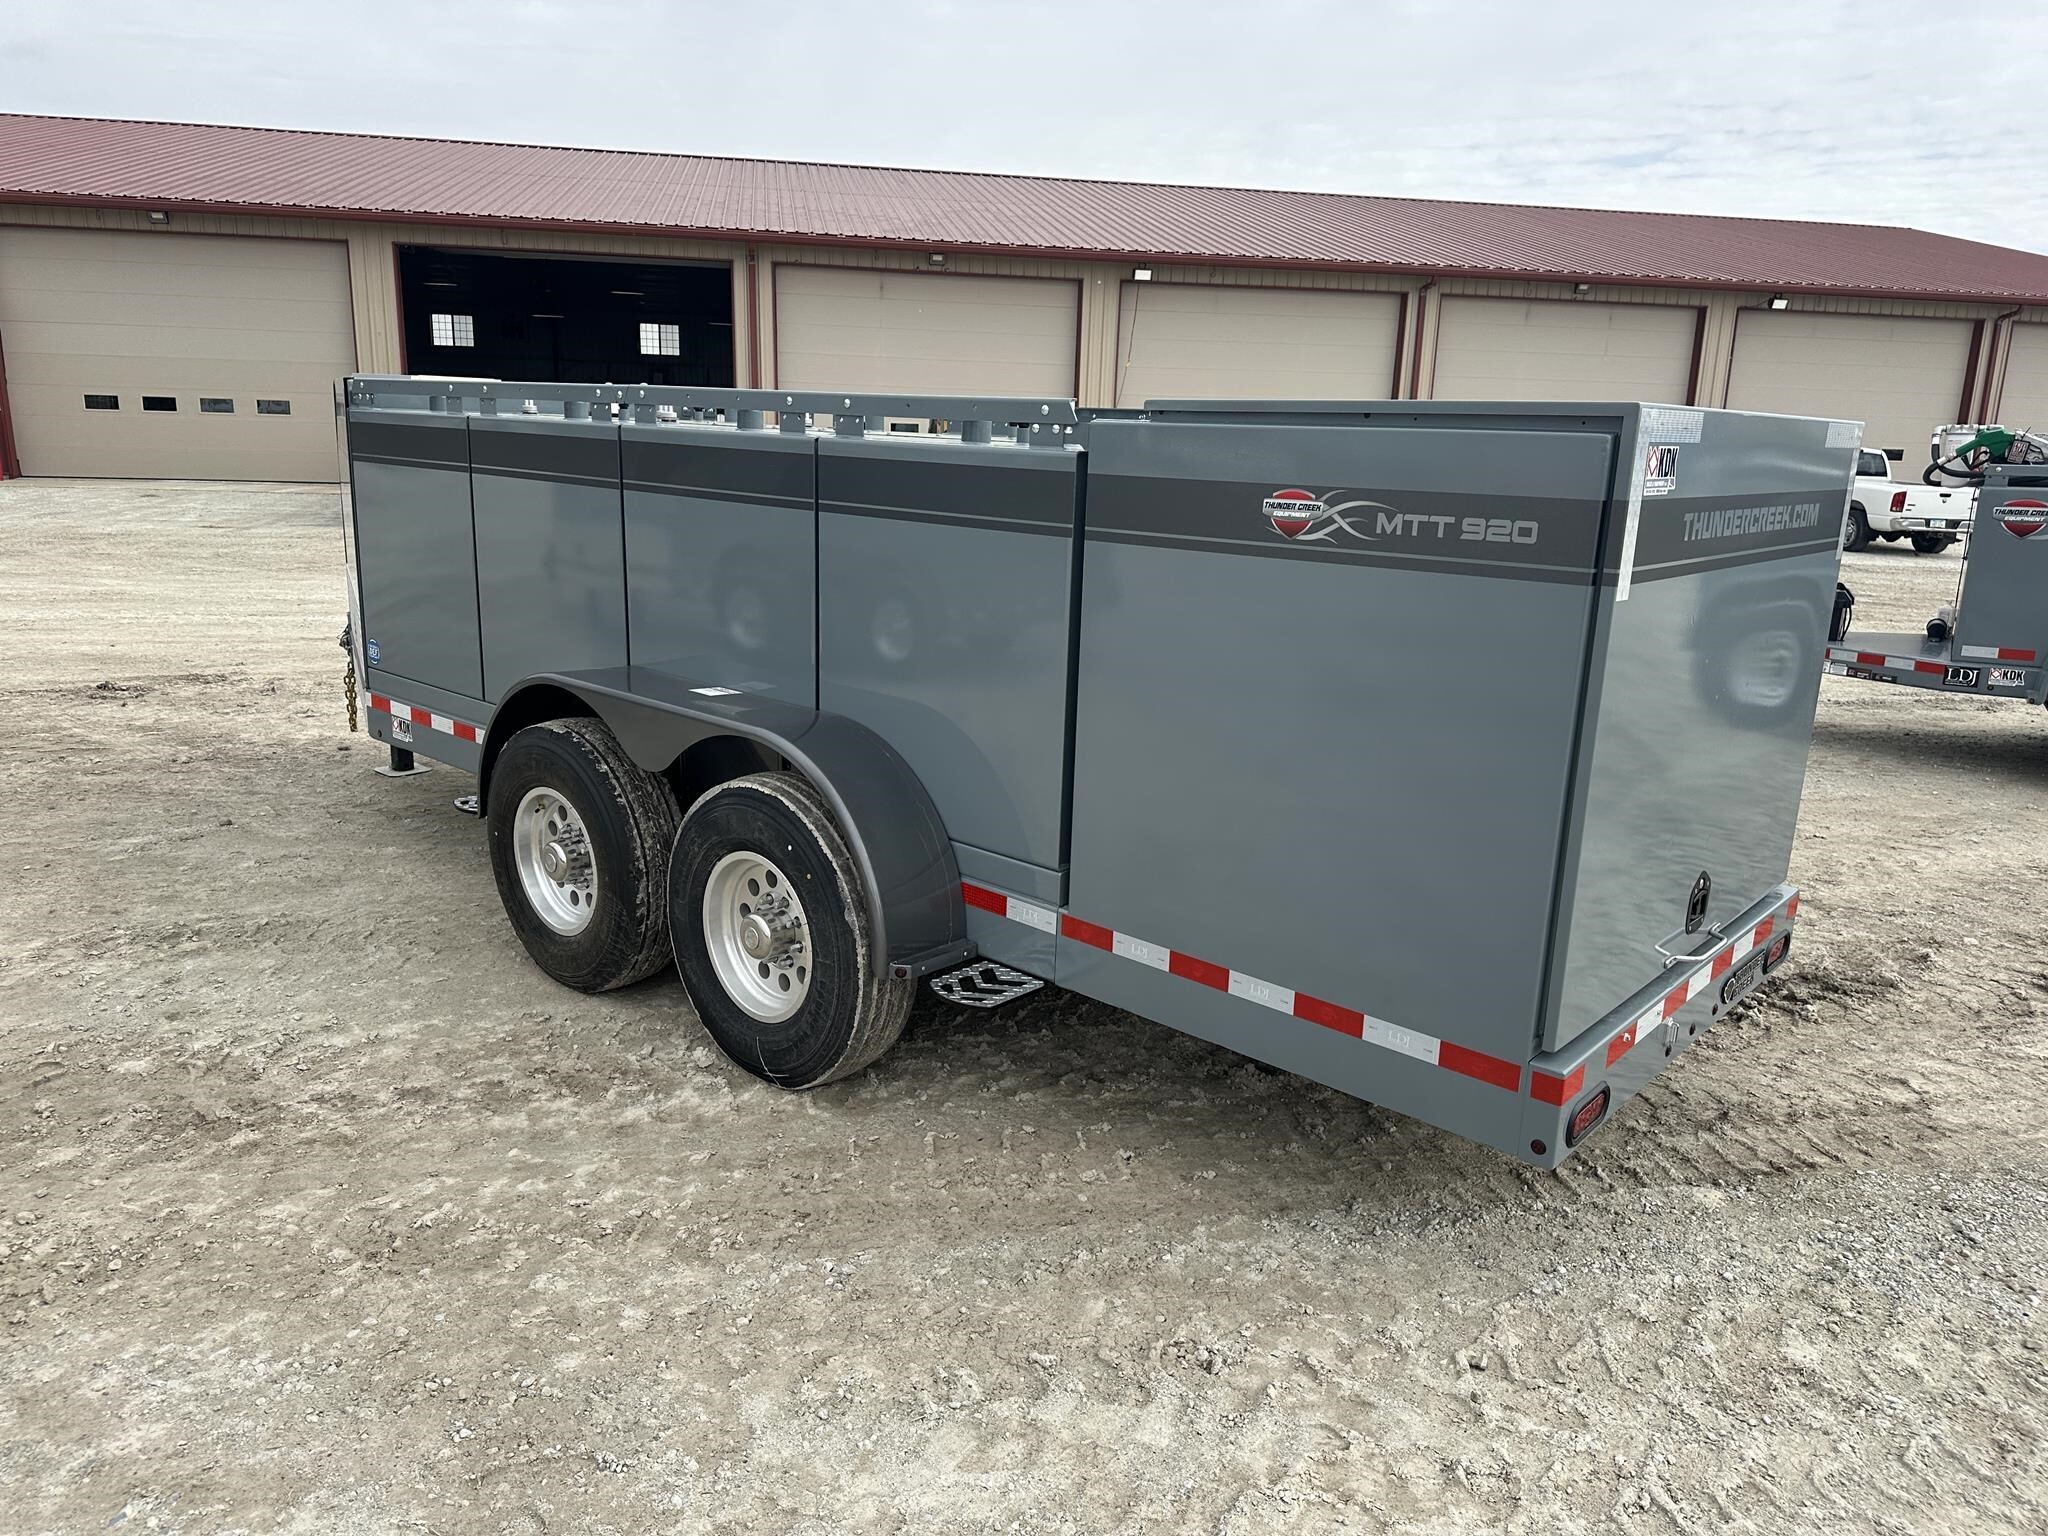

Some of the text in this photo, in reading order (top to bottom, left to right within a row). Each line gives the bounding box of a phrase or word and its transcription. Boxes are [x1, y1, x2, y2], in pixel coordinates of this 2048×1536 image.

[1657, 448, 1678, 478] KDK
[1264, 501, 1322, 512] THUNDER CREEK
[1272, 510, 1311, 518] EQUIPMENT
[1994, 508, 2029, 516] THUNDER
[1375, 512, 1539, 544] MTT 920
[1683, 503, 1821, 542] THUNDERCREEK.COM
[1947, 668, 1979, 686] LDJ
[2002, 670, 2024, 682] KDK
[398, 719, 411, 734] KDK
